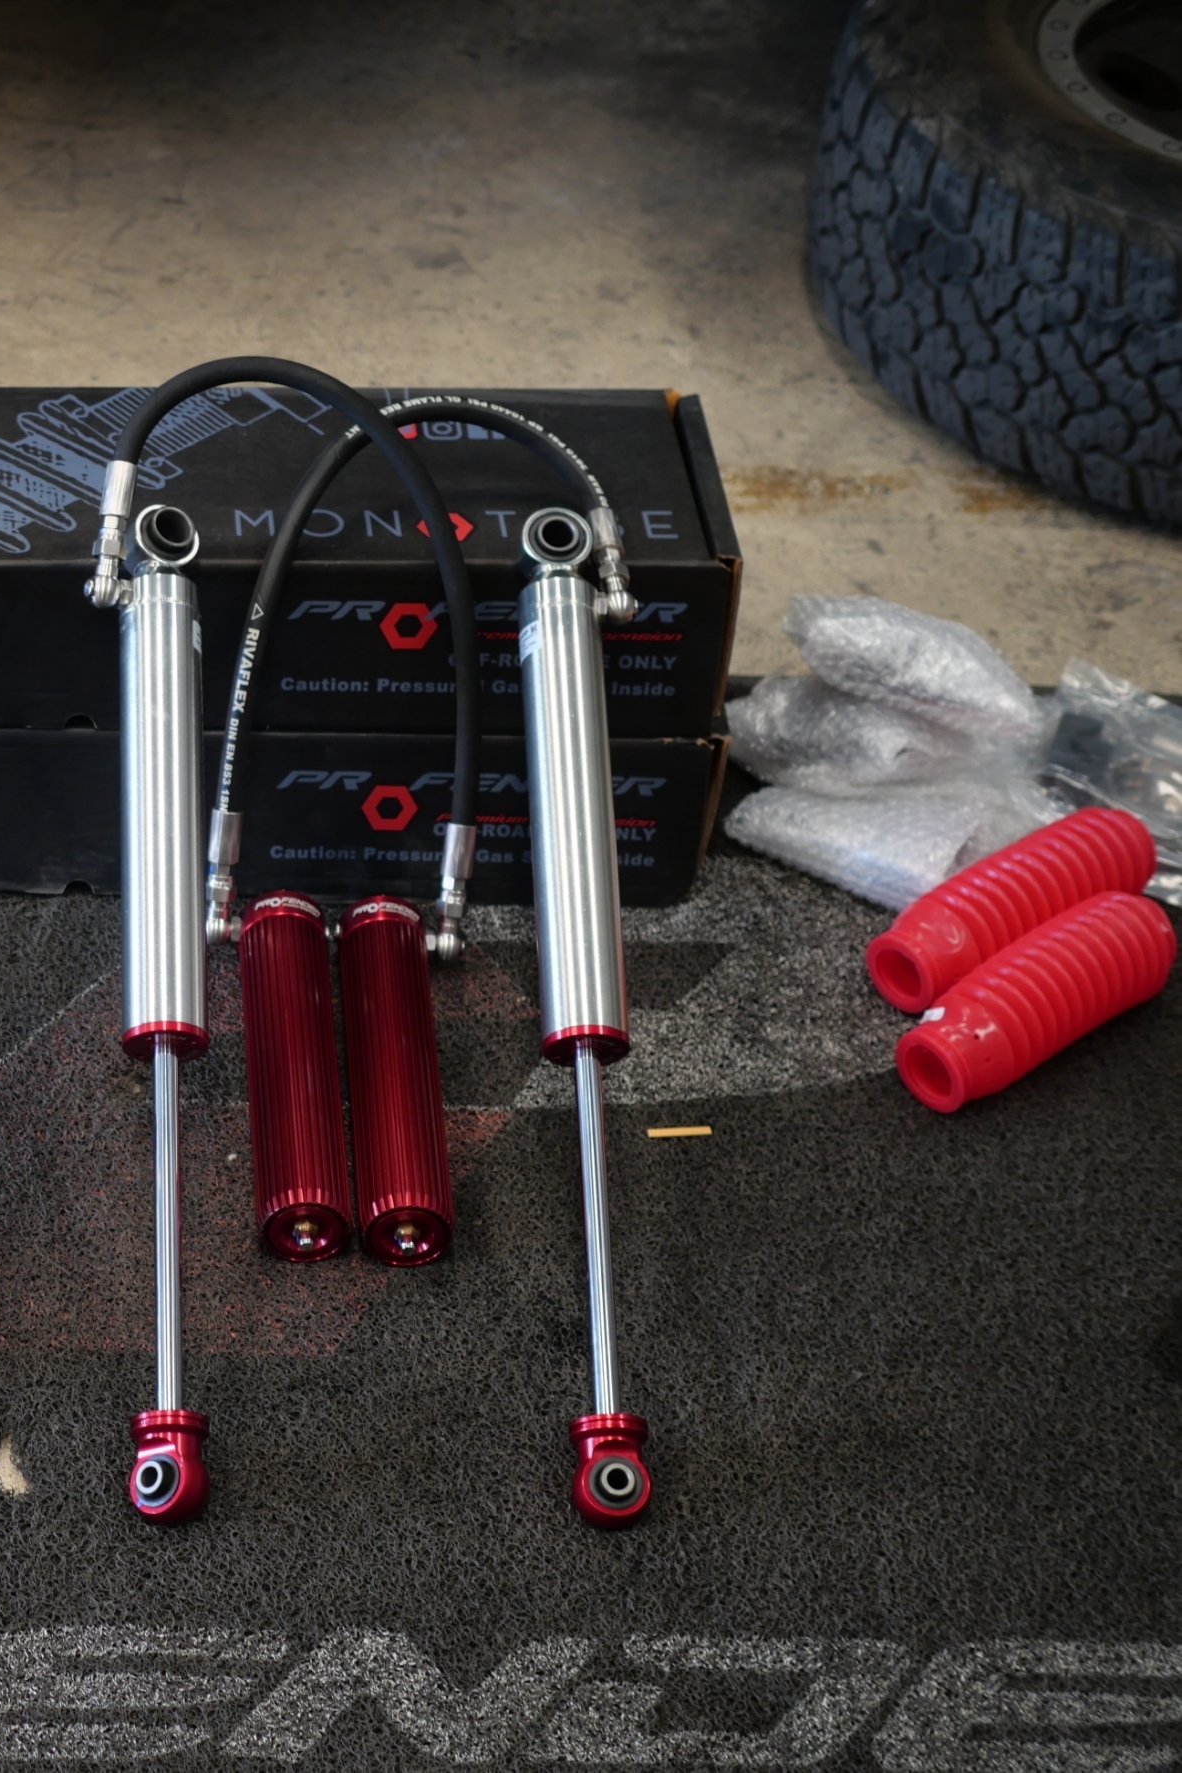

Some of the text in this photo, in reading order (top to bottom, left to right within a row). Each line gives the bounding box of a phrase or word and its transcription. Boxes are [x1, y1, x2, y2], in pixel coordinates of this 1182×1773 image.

[404, 395, 443, 408] FLAME
[232, 627, 261, 713] RIVAFLEX
[618, 655, 677, 669] ONLY
[280, 677, 369, 693] Caution:
[491, 680, 521, 695] Ga
[612, 681, 676, 697] Inside
[230, 718, 239, 741] DIN
[225, 744, 236, 761] EN
[222, 764, 233, 785] 853
[616, 828, 657, 842] NLY
[269, 845, 356, 861] Caution:
[476, 849, 514, 864] Gas
[616, 853, 655, 868] side
[254, 896, 321, 917] PROFENDER
[352, 902, 420, 921] PROFENDER
